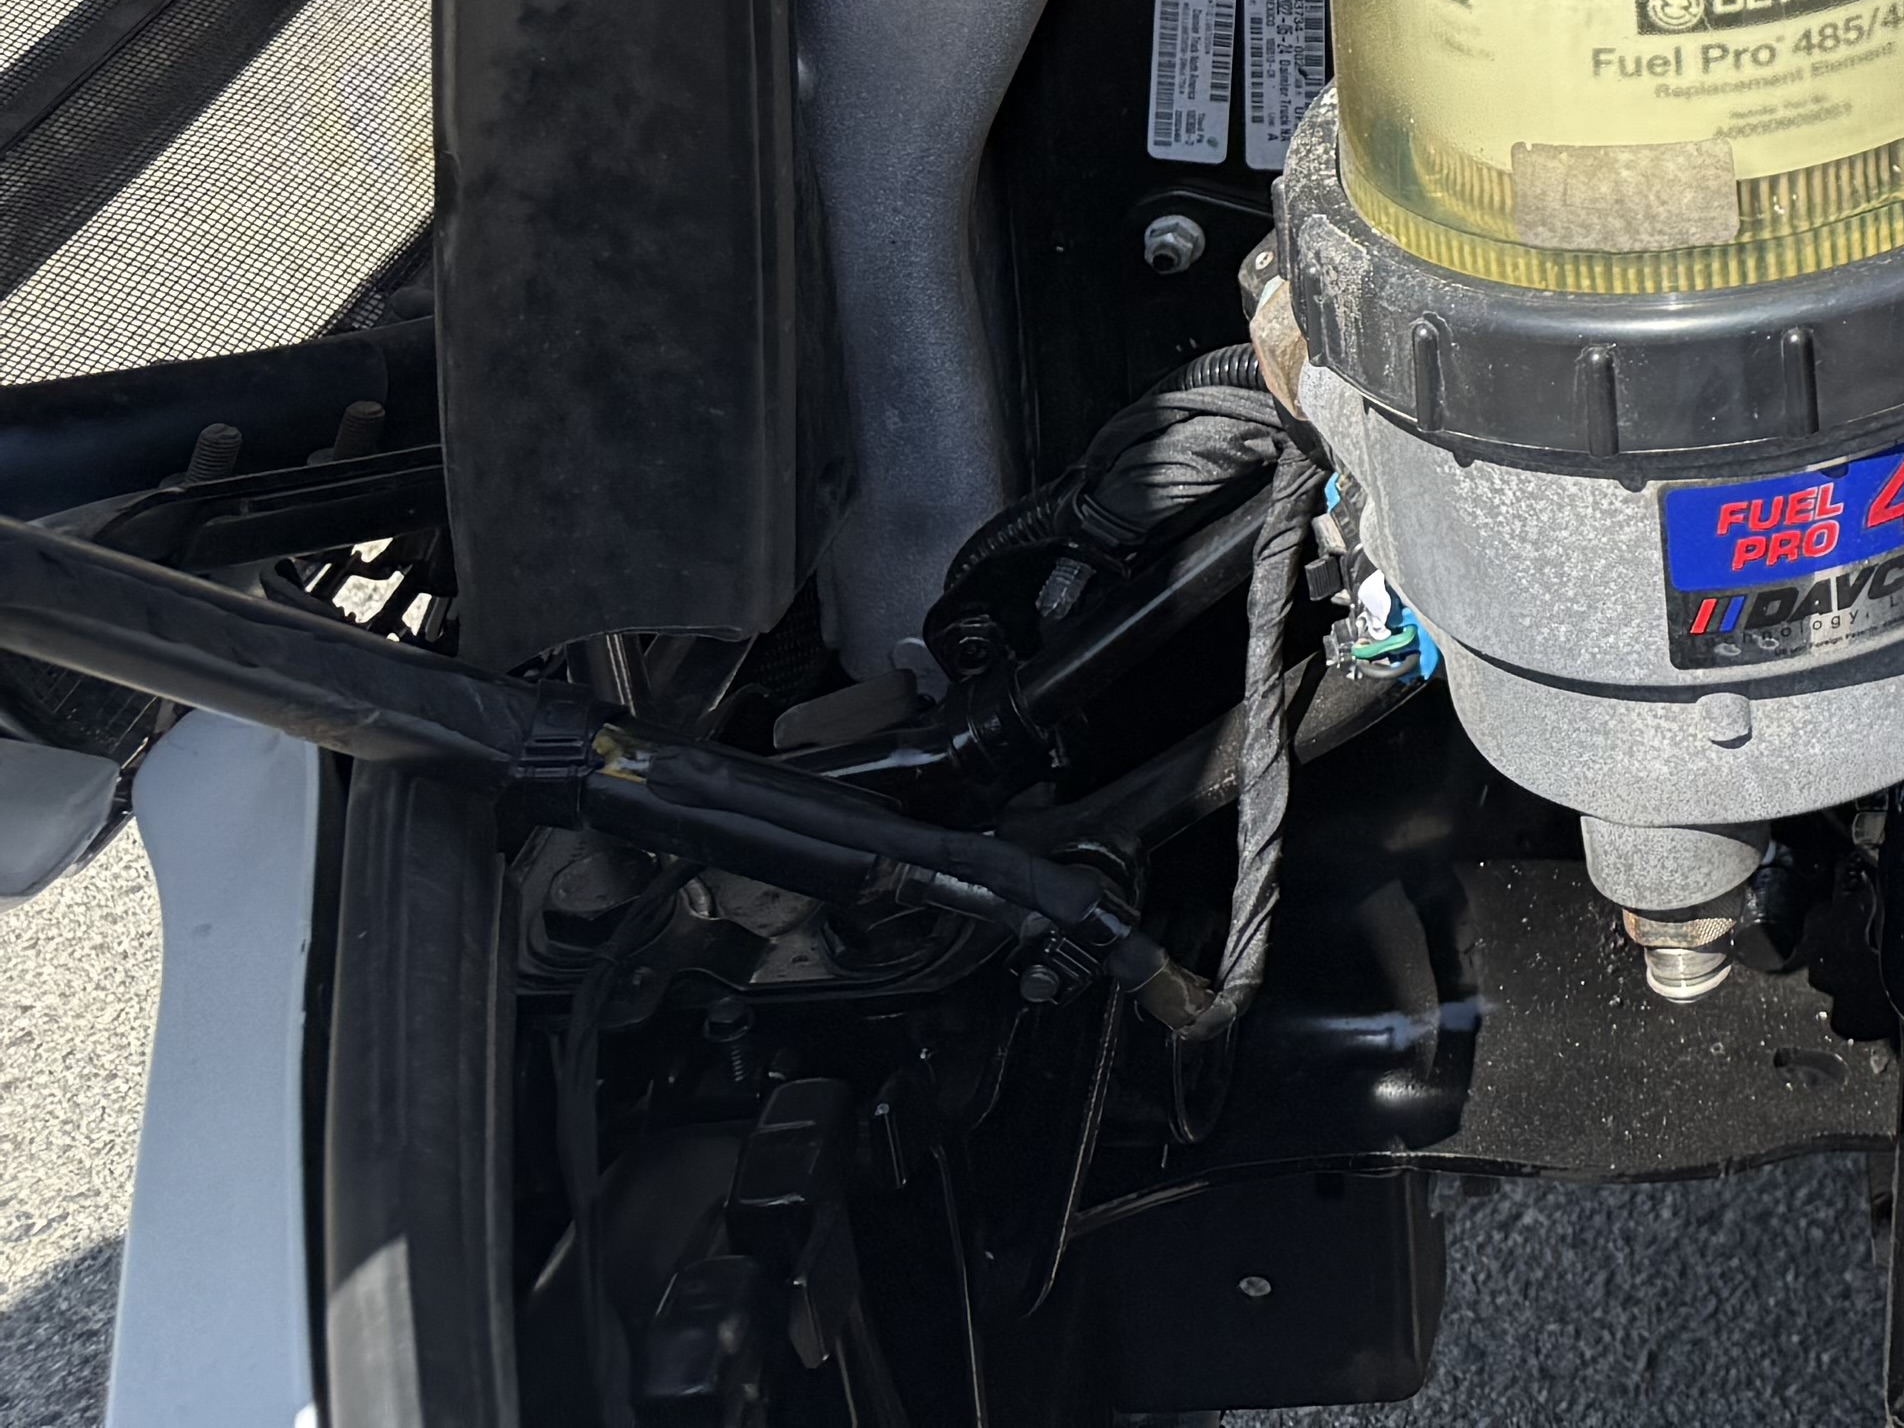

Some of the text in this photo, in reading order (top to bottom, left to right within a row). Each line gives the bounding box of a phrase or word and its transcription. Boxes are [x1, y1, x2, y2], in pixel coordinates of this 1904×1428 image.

[1279, 59, 1292, 96] Daimler
[1592, 45, 1683, 78] Fuel
[1700, 42, 1777, 76] Pro
[1654, 41, 1897, 99] Replacement Element
[1279, 98, 1291, 126] Truck
[1267, 133, 1277, 142] A
[1716, 482, 1845, 535] FUEL
[1731, 519, 1840, 572] PRO
